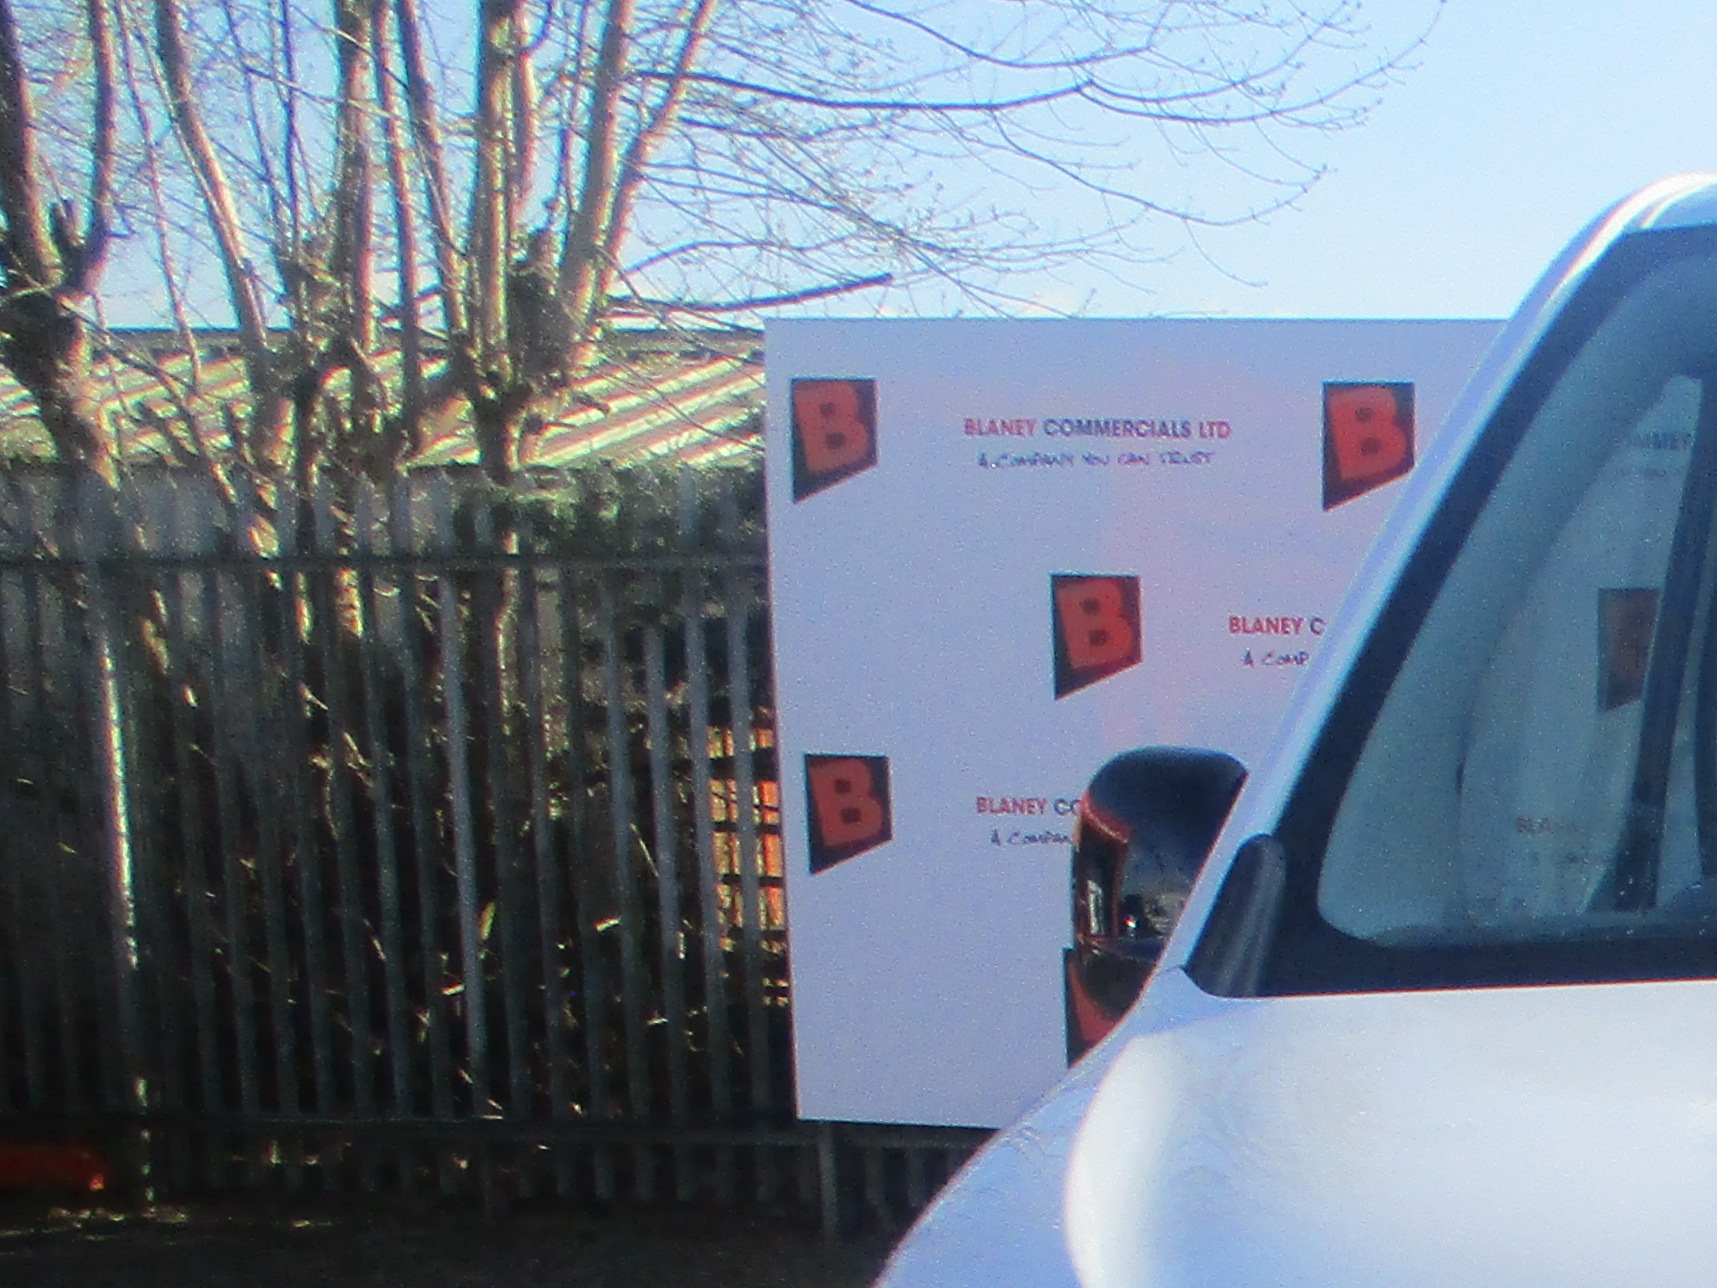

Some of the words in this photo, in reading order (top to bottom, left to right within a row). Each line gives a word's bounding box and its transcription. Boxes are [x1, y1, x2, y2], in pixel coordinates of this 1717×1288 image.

[794, 381, 868, 473] B
[964, 418, 1037, 436] BLANEY
[1043, 418, 1192, 438] COMMERCIALS
[1199, 420, 1232, 438] LTD
[1328, 386, 1406, 479] B
[997, 452, 1074, 467] COMPANY
[1082, 451, 1110, 466] YOU
[1117, 452, 1150, 466] CAN
[1159, 451, 1215, 465] TRUST
[1057, 579, 1131, 668] B
[1229, 616, 1304, 635] BLANEY
[809, 759, 883, 846] B
[976, 797, 1048, 815] BLANEY
